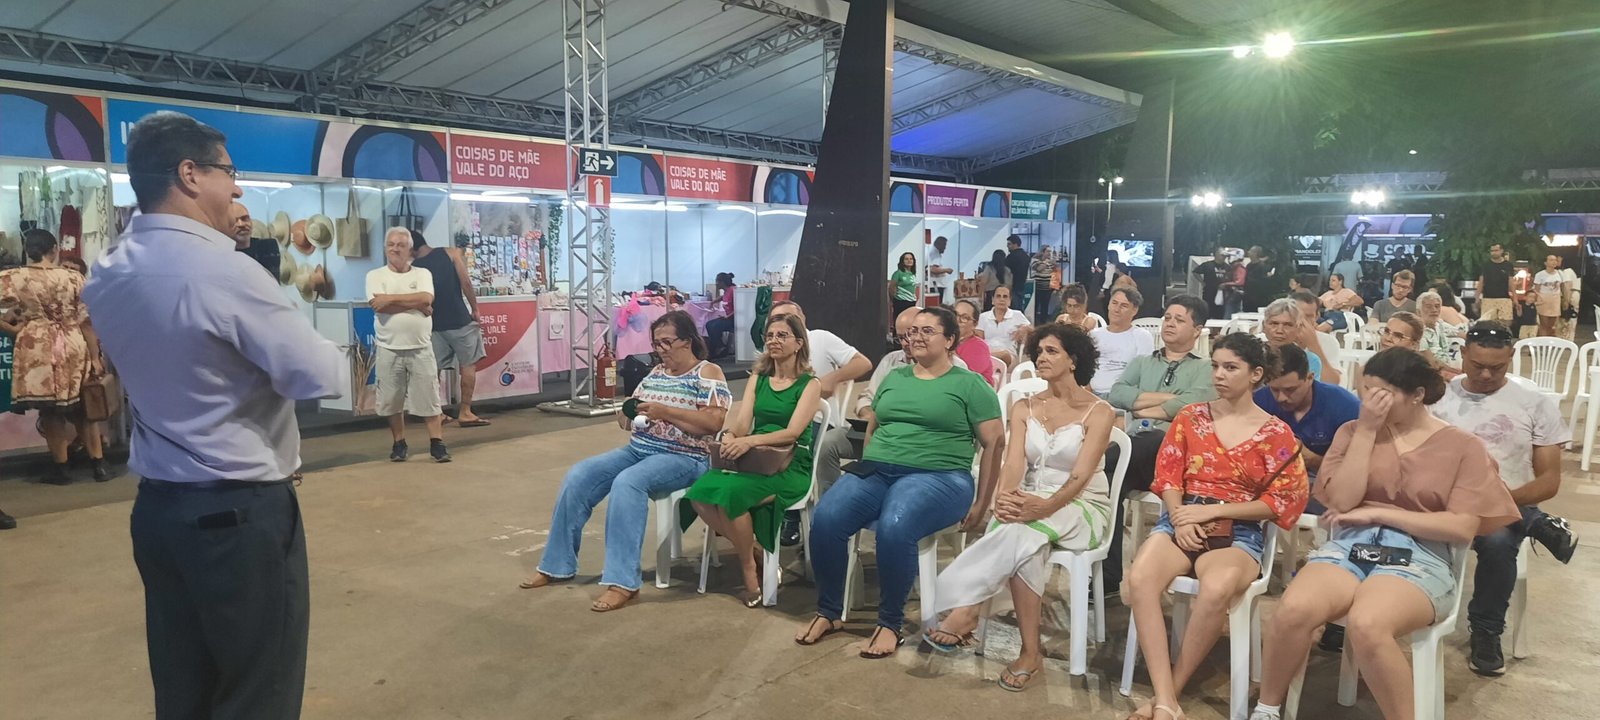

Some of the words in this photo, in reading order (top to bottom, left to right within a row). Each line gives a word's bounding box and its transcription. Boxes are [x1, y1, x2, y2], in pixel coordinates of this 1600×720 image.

[455, 145, 496, 161] COISAS
[499, 149, 515, 163] DE
[518, 149, 540, 165] MÃE
[455, 161, 485, 176] VALE
[489, 164, 505, 178] DO
[508, 166, 530, 181] AÇO
[669, 165, 697, 178] COISAS
[698, 168, 709, 180] DE
[710, 167, 727, 181] MÃE
[670, 178, 690, 190] VALE
[691, 180, 703, 192] DO
[704, 181, 720, 195] AÇO
[927, 195, 953, 206] PRODUTOS
[497, 314, 508, 323] DE
[487, 325, 507, 334] VALE
